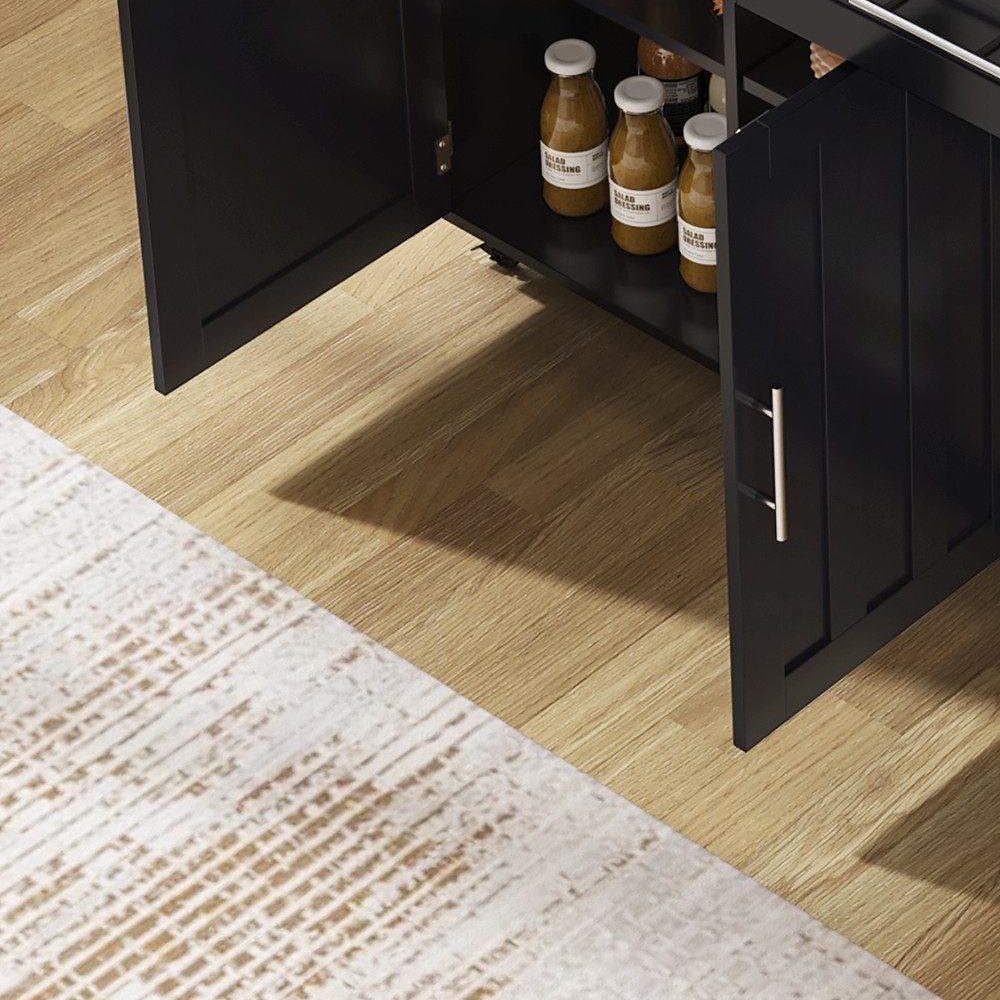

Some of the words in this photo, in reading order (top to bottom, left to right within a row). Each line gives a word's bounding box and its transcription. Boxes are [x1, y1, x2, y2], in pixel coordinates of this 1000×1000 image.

[544, 151, 566, 165] SALAD
[545, 159, 581, 173] DRESSING
[614, 189, 635, 203] SALAD
[614, 197, 650, 212] DRESSING
[683, 227, 705, 241] SALAD
